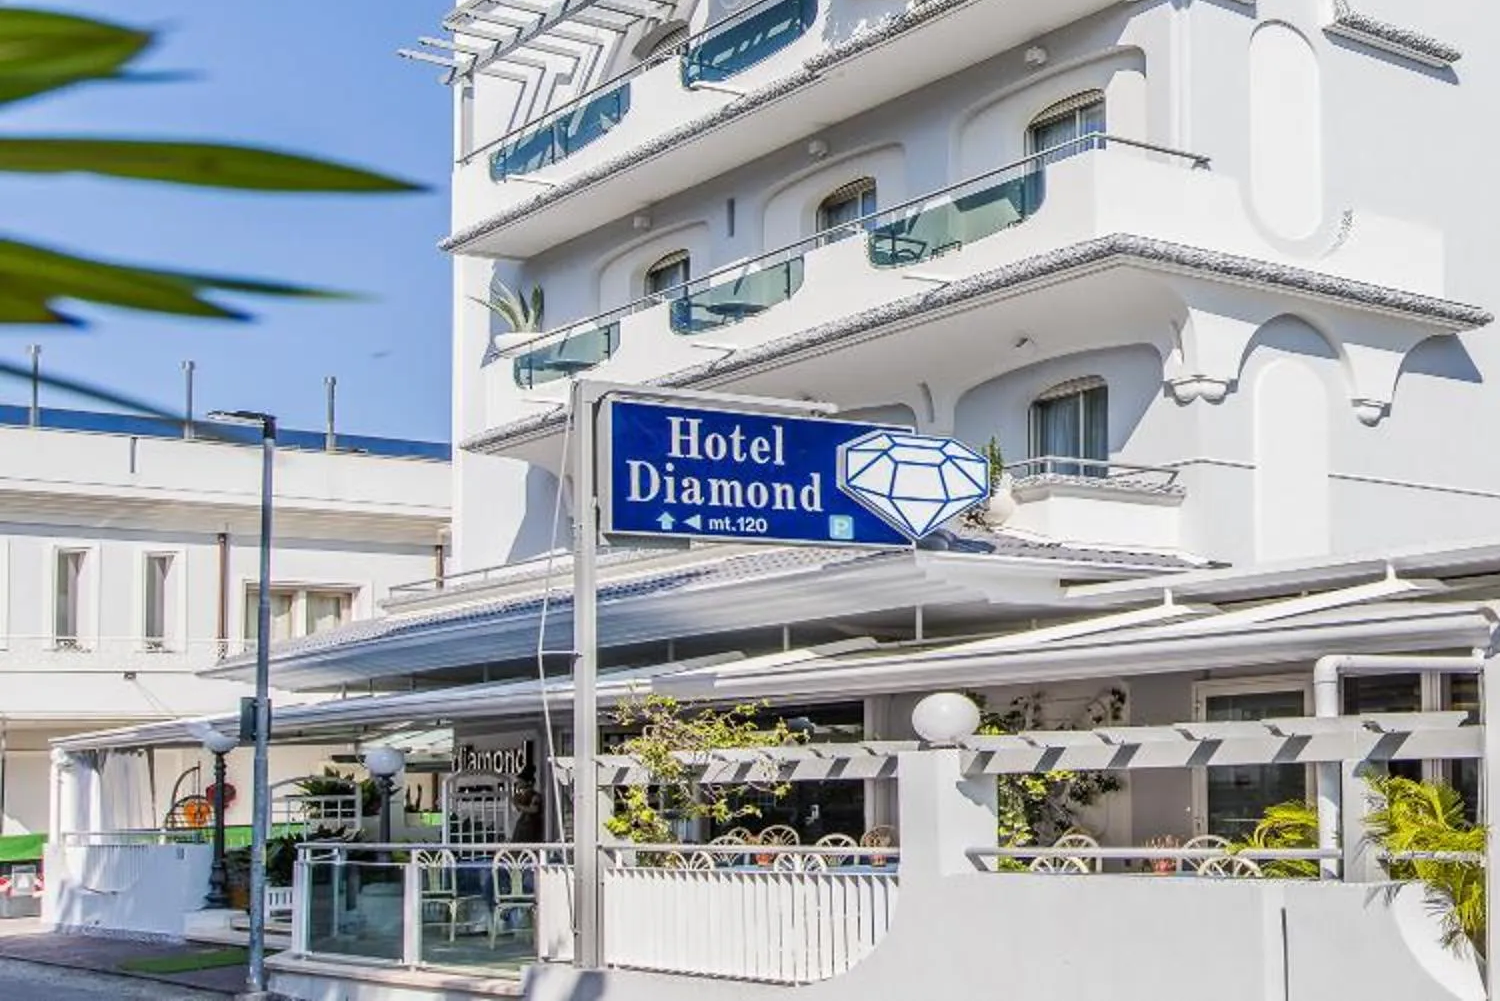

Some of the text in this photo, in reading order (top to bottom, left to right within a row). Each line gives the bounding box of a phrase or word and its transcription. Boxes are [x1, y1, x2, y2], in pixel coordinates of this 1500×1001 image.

[666, 416, 785, 466] Hotel
[625, 459, 824, 512] Diamond
[708, 516, 768, 533] mt.120
